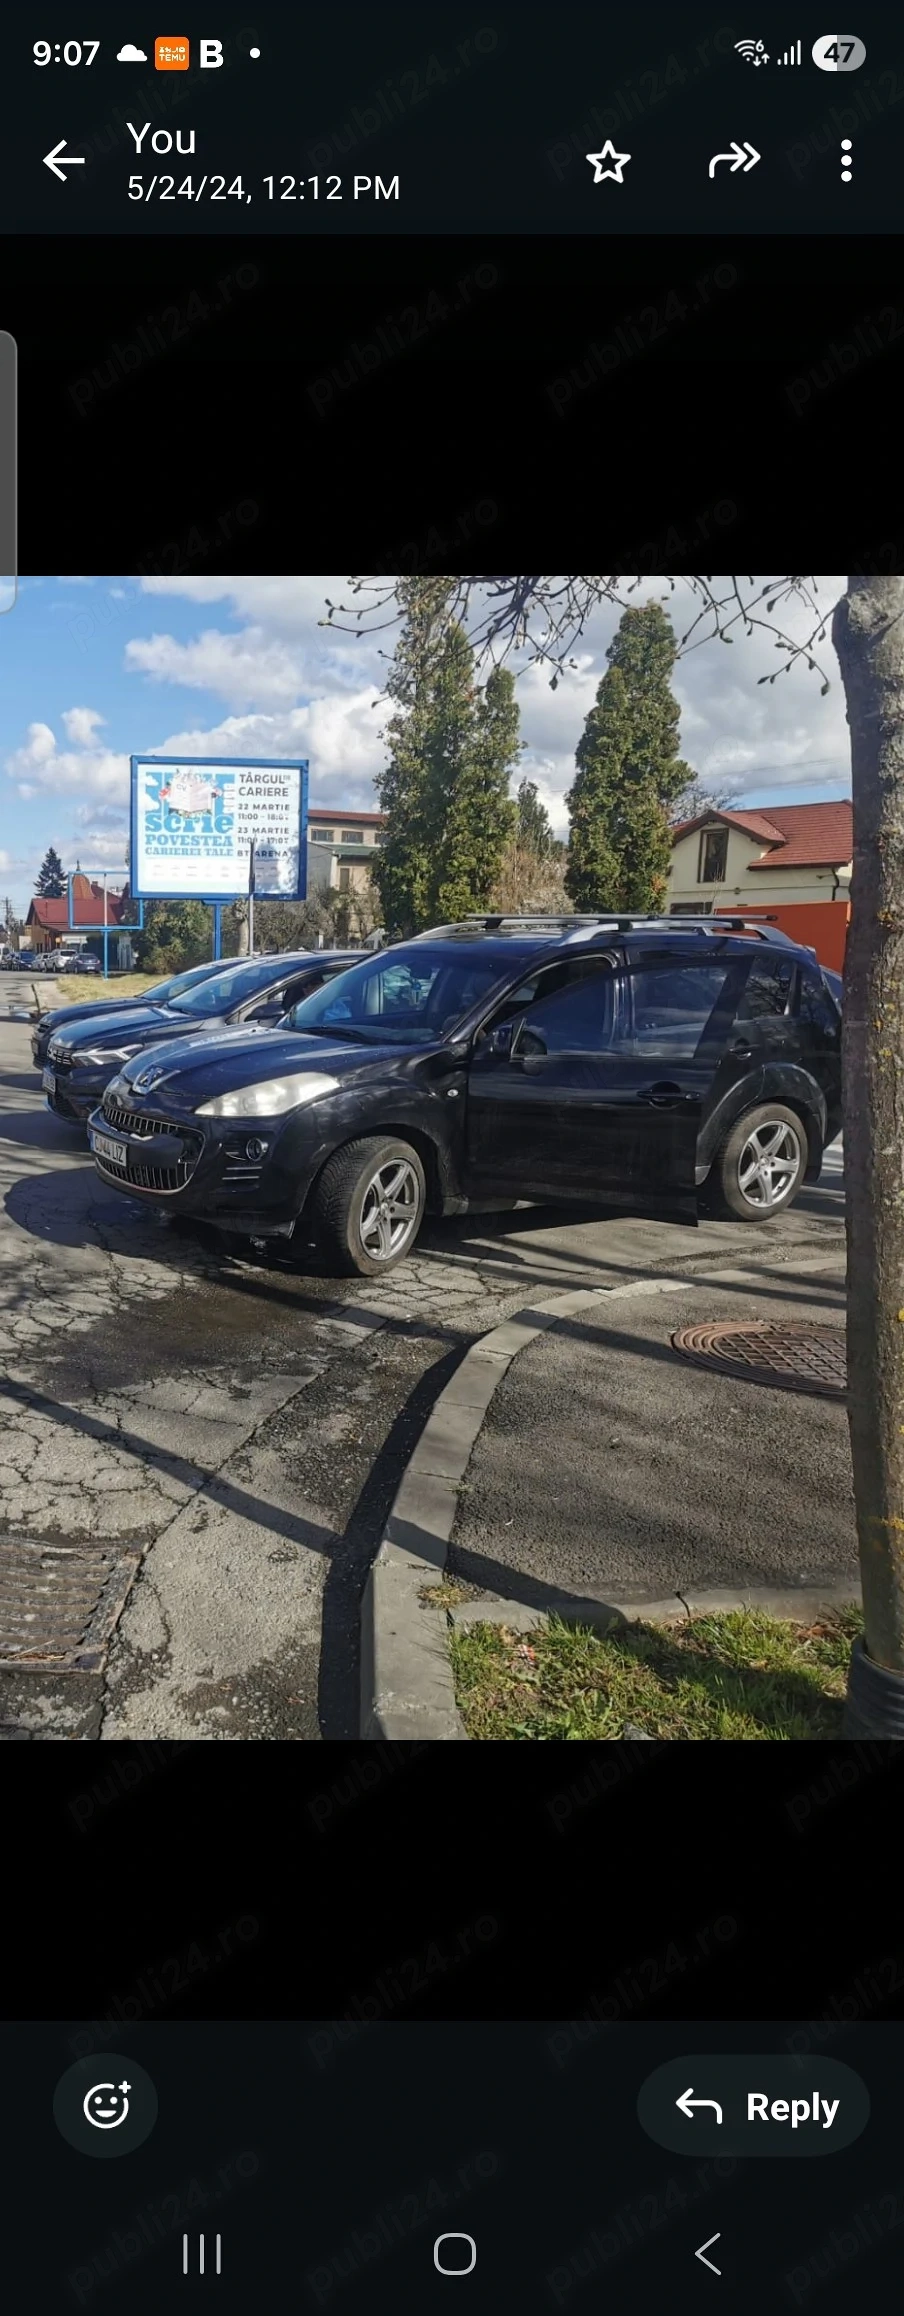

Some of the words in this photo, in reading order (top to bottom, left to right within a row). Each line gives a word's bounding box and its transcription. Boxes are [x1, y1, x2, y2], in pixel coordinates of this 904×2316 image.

[33, 41, 100, 66] 9:07
[159, 53, 186, 62] TEMU
[199, 39, 224, 69] B
[823, 42, 856, 63] 47
[126, 122, 196, 155] You
[127, 175, 252, 204] 5/24/24,
[262, 175, 343, 200] 12:12
[353, 175, 400, 200] PM
[239, 772, 285, 784] TÂRGUL
[238, 787, 289, 797] CARIERE
[145, 814, 233, 834] scrie
[252, 827, 290, 835] MARTIE
[145, 834, 233, 847] POVESTEA
[145, 847, 202, 857] CARIEREI
[204, 847, 234, 857] TALE
[747, 2091, 841, 2129] Reply
